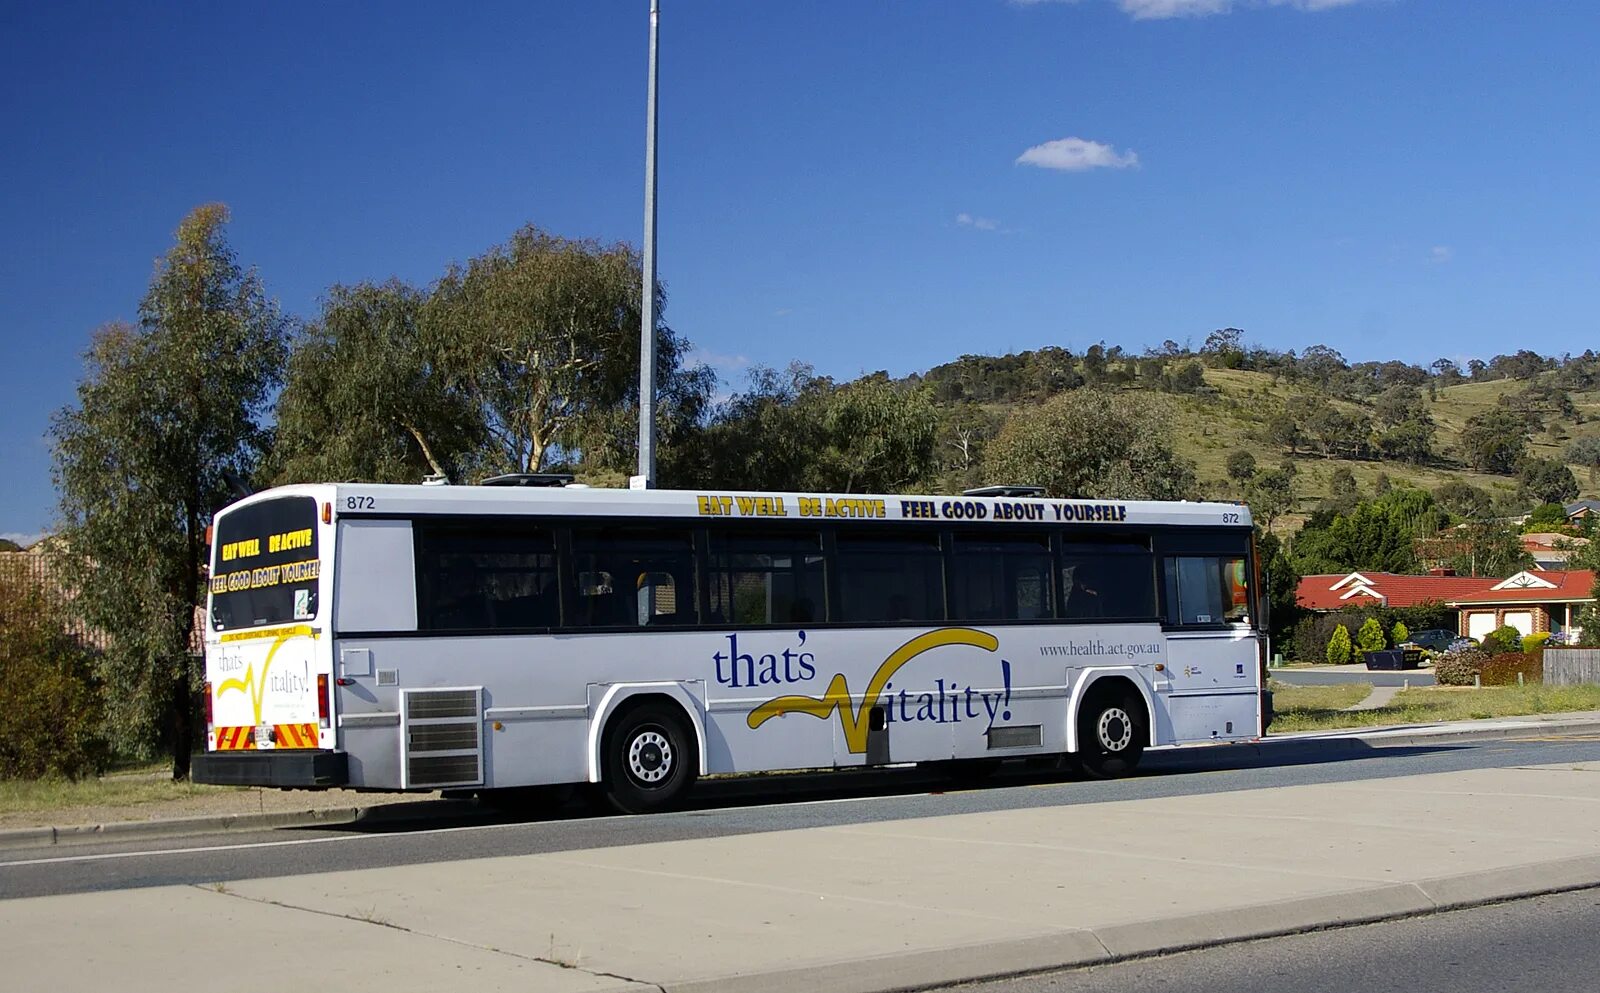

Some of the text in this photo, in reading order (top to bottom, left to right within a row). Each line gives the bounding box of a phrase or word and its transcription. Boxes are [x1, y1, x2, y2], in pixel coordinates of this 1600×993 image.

[347, 496, 375, 509] 872
[697, 496, 887, 518] EAT WELL BE ACTIVE
[900, 501, 1127, 522] FEEL GOOD ABOUT YOURSELF
[1222, 513, 1239, 524] 872
[222, 528, 312, 561] EAT WELL BE ACTIVE
[228, 570, 251, 592] GOOD
[250, 565, 280, 589] ABOUT
[712, 630, 816, 688] that's
[1039, 640, 1160, 660] www.health.act.gov.au
